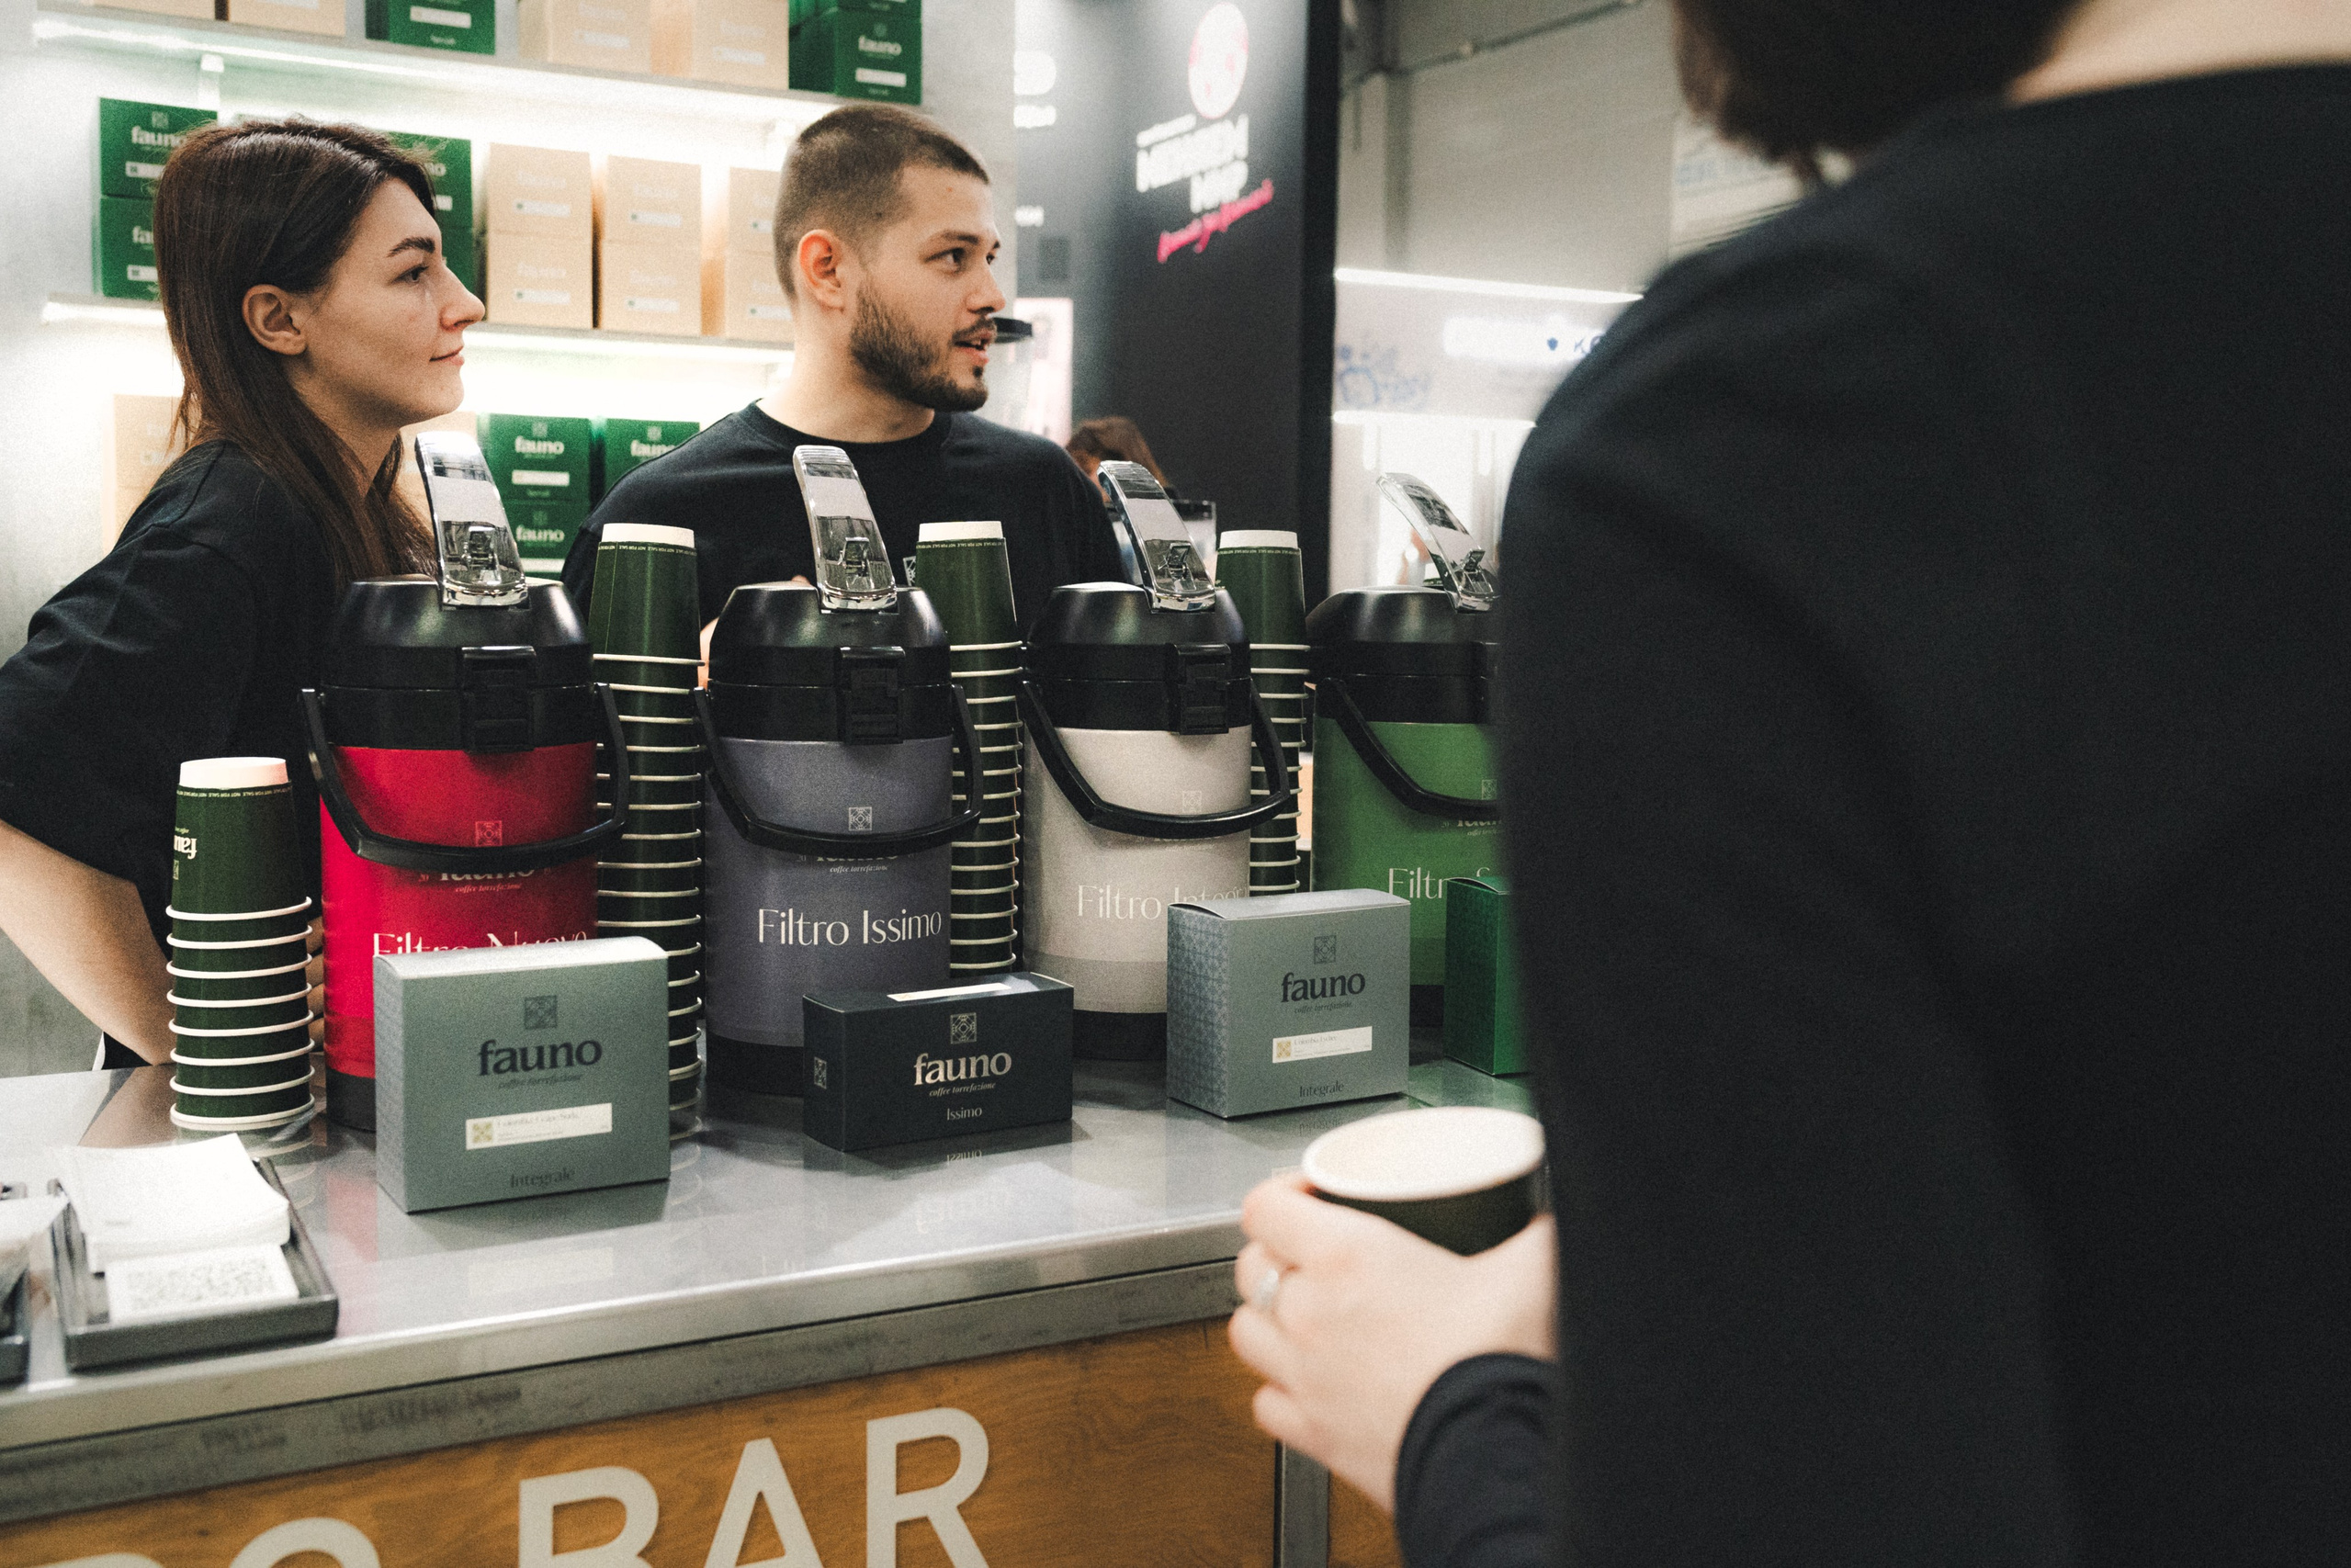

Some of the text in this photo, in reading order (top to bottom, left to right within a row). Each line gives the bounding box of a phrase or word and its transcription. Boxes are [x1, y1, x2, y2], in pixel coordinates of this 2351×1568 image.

[173, 834, 198, 860] fau
[1388, 866, 1449, 899] Filtr
[1078, 884, 1162, 919] Filtro
[758, 908, 942, 946] Filtro Issimo
[1281, 972, 1366, 1003] fauno
[478, 1039, 603, 1077] fauno
[913, 1052, 1012, 1086] fauno
[946, 1106, 983, 1121] Issimo
[518, 1407, 991, 1568] BAR
